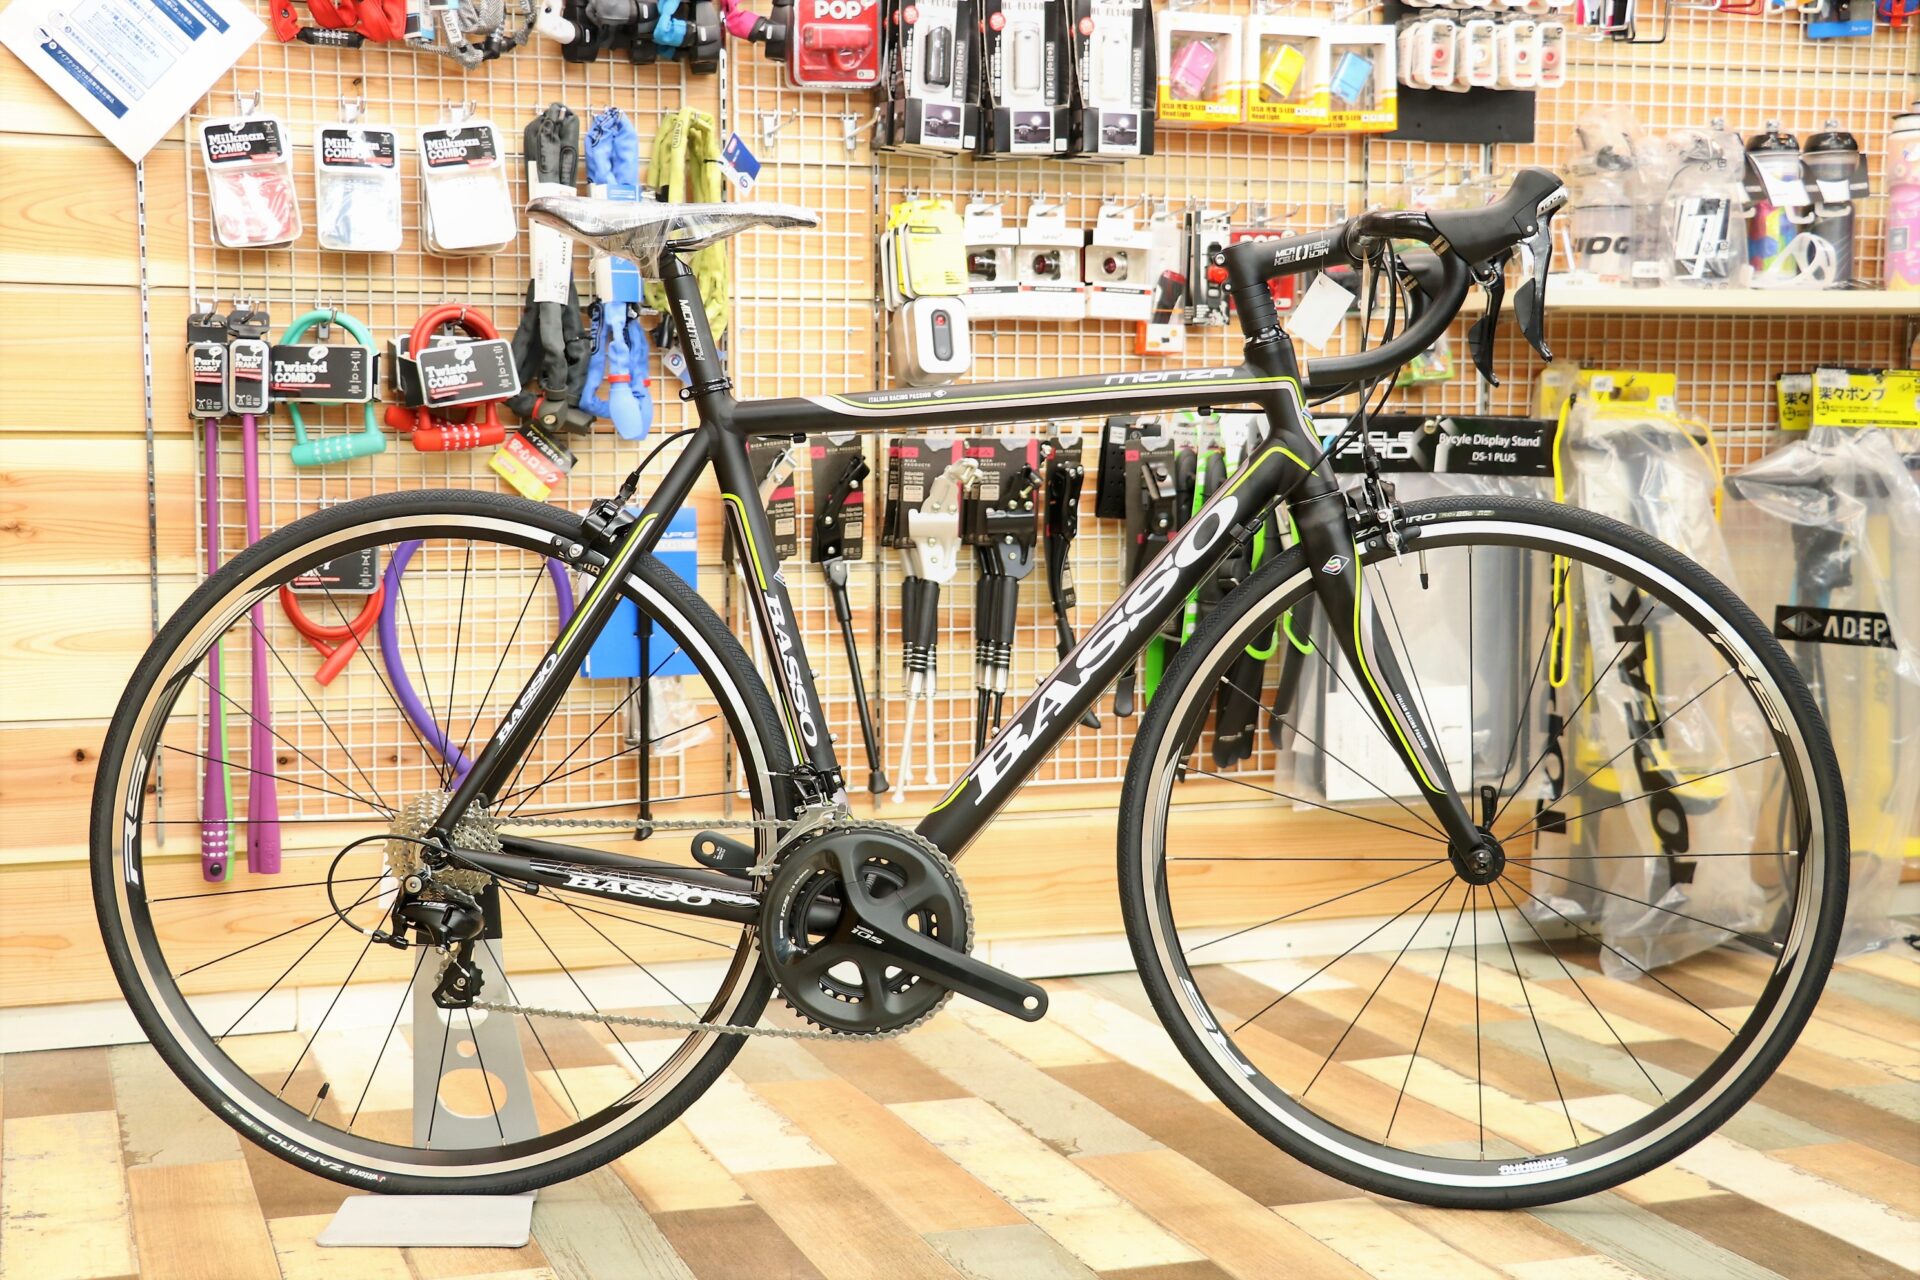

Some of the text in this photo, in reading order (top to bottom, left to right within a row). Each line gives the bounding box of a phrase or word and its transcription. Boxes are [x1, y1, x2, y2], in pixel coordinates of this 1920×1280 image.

[814, 0, 862, 20] POP
[208, 132, 265, 145] Milkman
[426, 138, 481, 151] Milkman
[209, 141, 251, 154] COMBO
[428, 147, 468, 159] COMBO
[194, 357, 221, 368] Party
[235, 353, 262, 364] Party
[274, 361, 328, 373] Twisted
[425, 360, 477, 378] Twisted
[274, 372, 316, 383] COMBO
[428, 374, 468, 389] COMBO
[868, 395, 889, 403] ITALIAN
[1439, 432, 1540, 447] Bycyle Display Stand
[1472, 452, 1516, 462] DS-1 PLUS
[969, 495, 1238, 806] BASSO
[764, 593, 818, 747] BASSO
[493, 652, 560, 746] BASSO
[563, 874, 712, 907] BASSO
[851, 928, 885, 945] 105
[267, 1134, 344, 1171] ZAFFIRO
